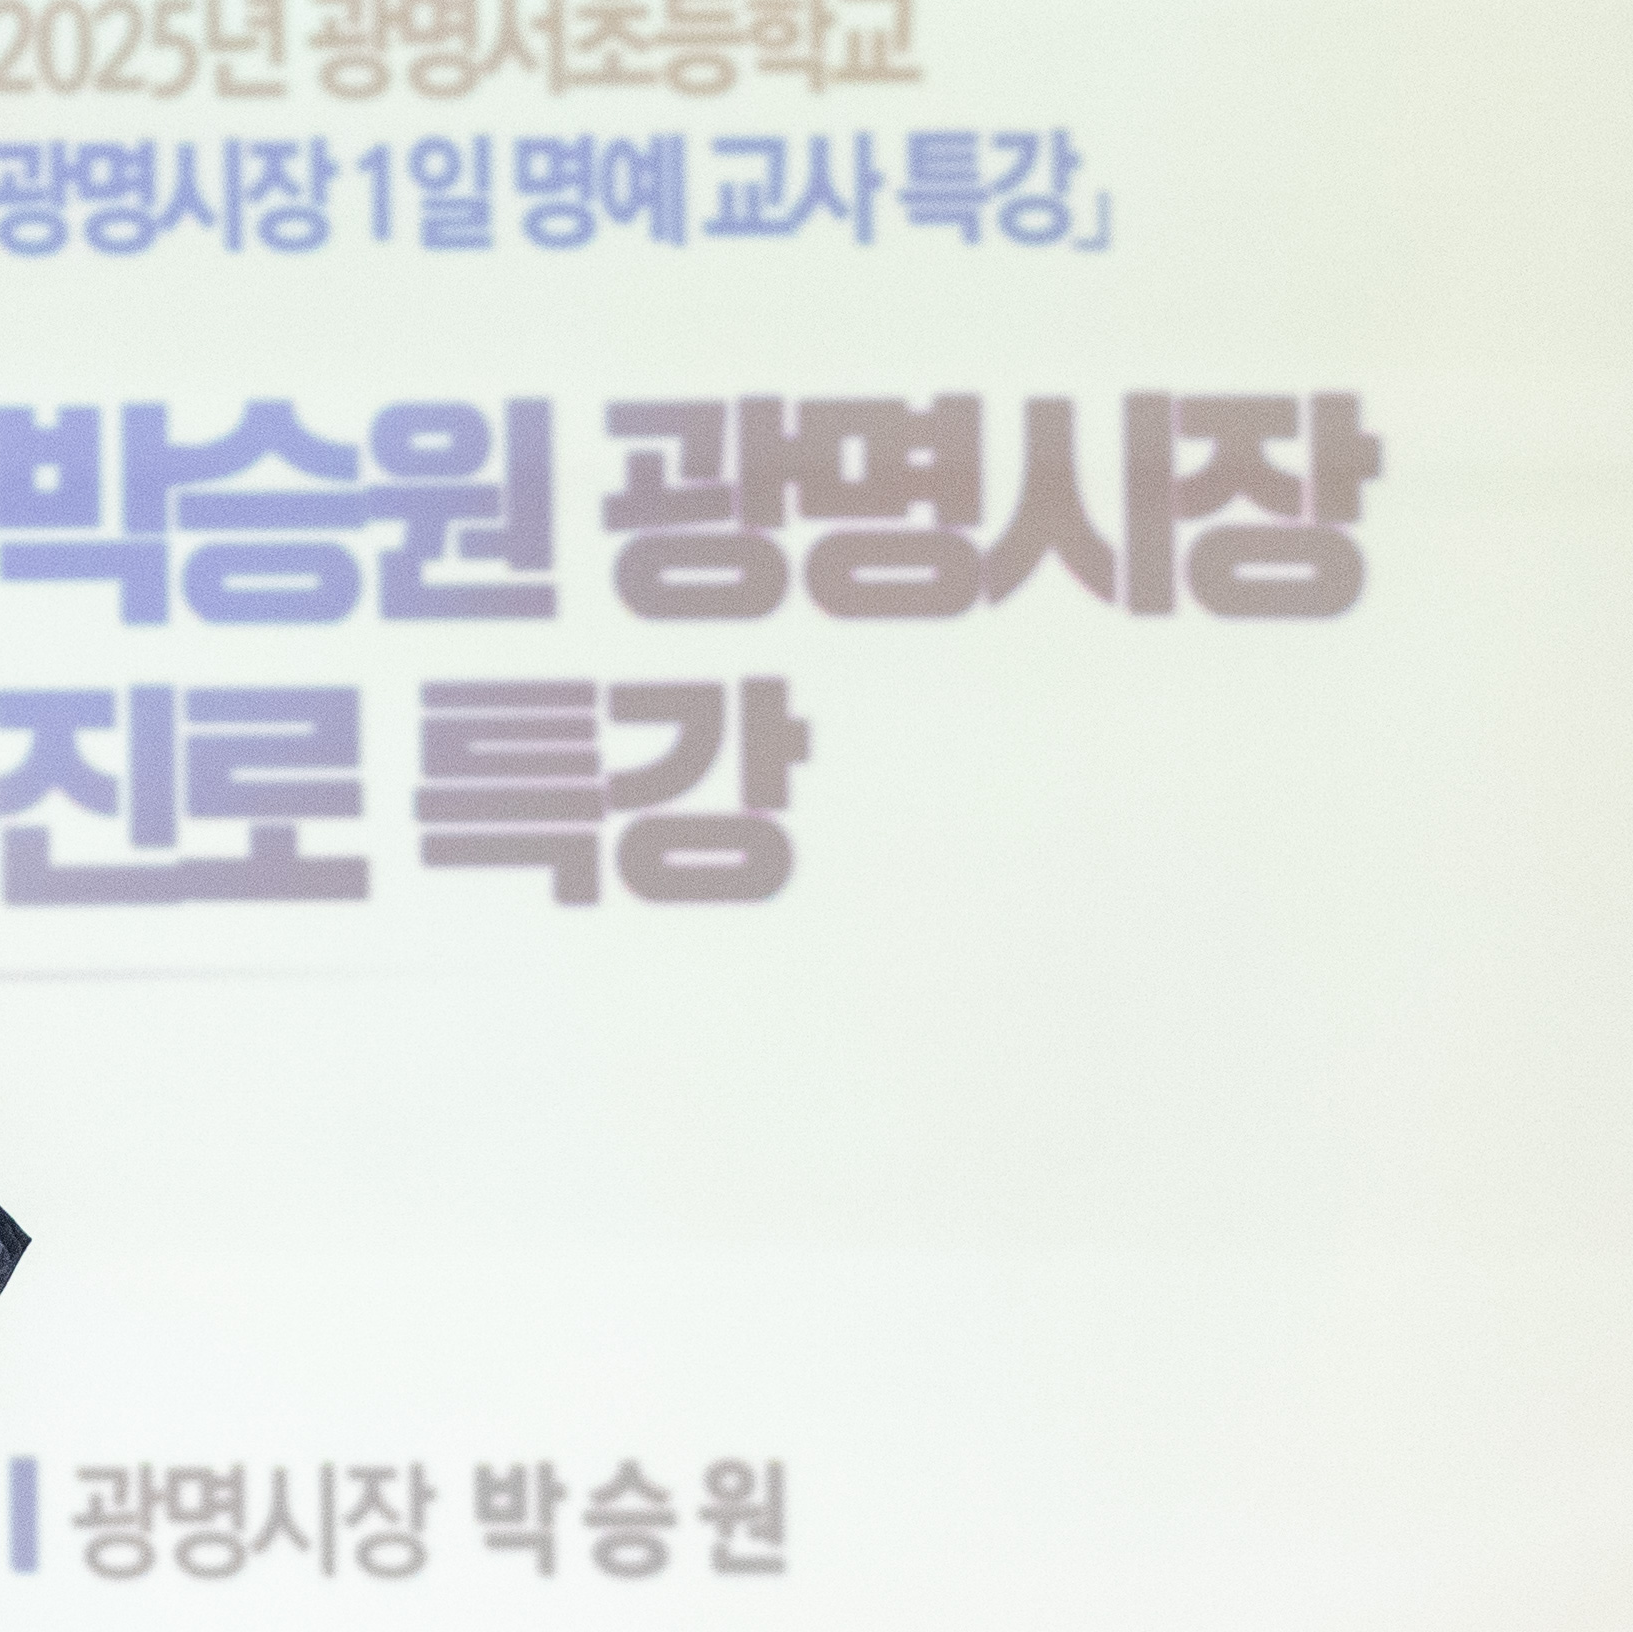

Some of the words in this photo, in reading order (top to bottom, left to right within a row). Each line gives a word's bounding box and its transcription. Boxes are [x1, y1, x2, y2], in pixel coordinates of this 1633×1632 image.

[307, 0, 923, 100] 광명서초등학교
[356, 133, 495, 253] 1일
[513, 133, 688, 251] 명예
[701, 131, 886, 247] 교사
[601, 391, 1384, 622] 광명시장
[412, 675, 812, 907] 특강
[71, 1462, 438, 1582] 광명시장
